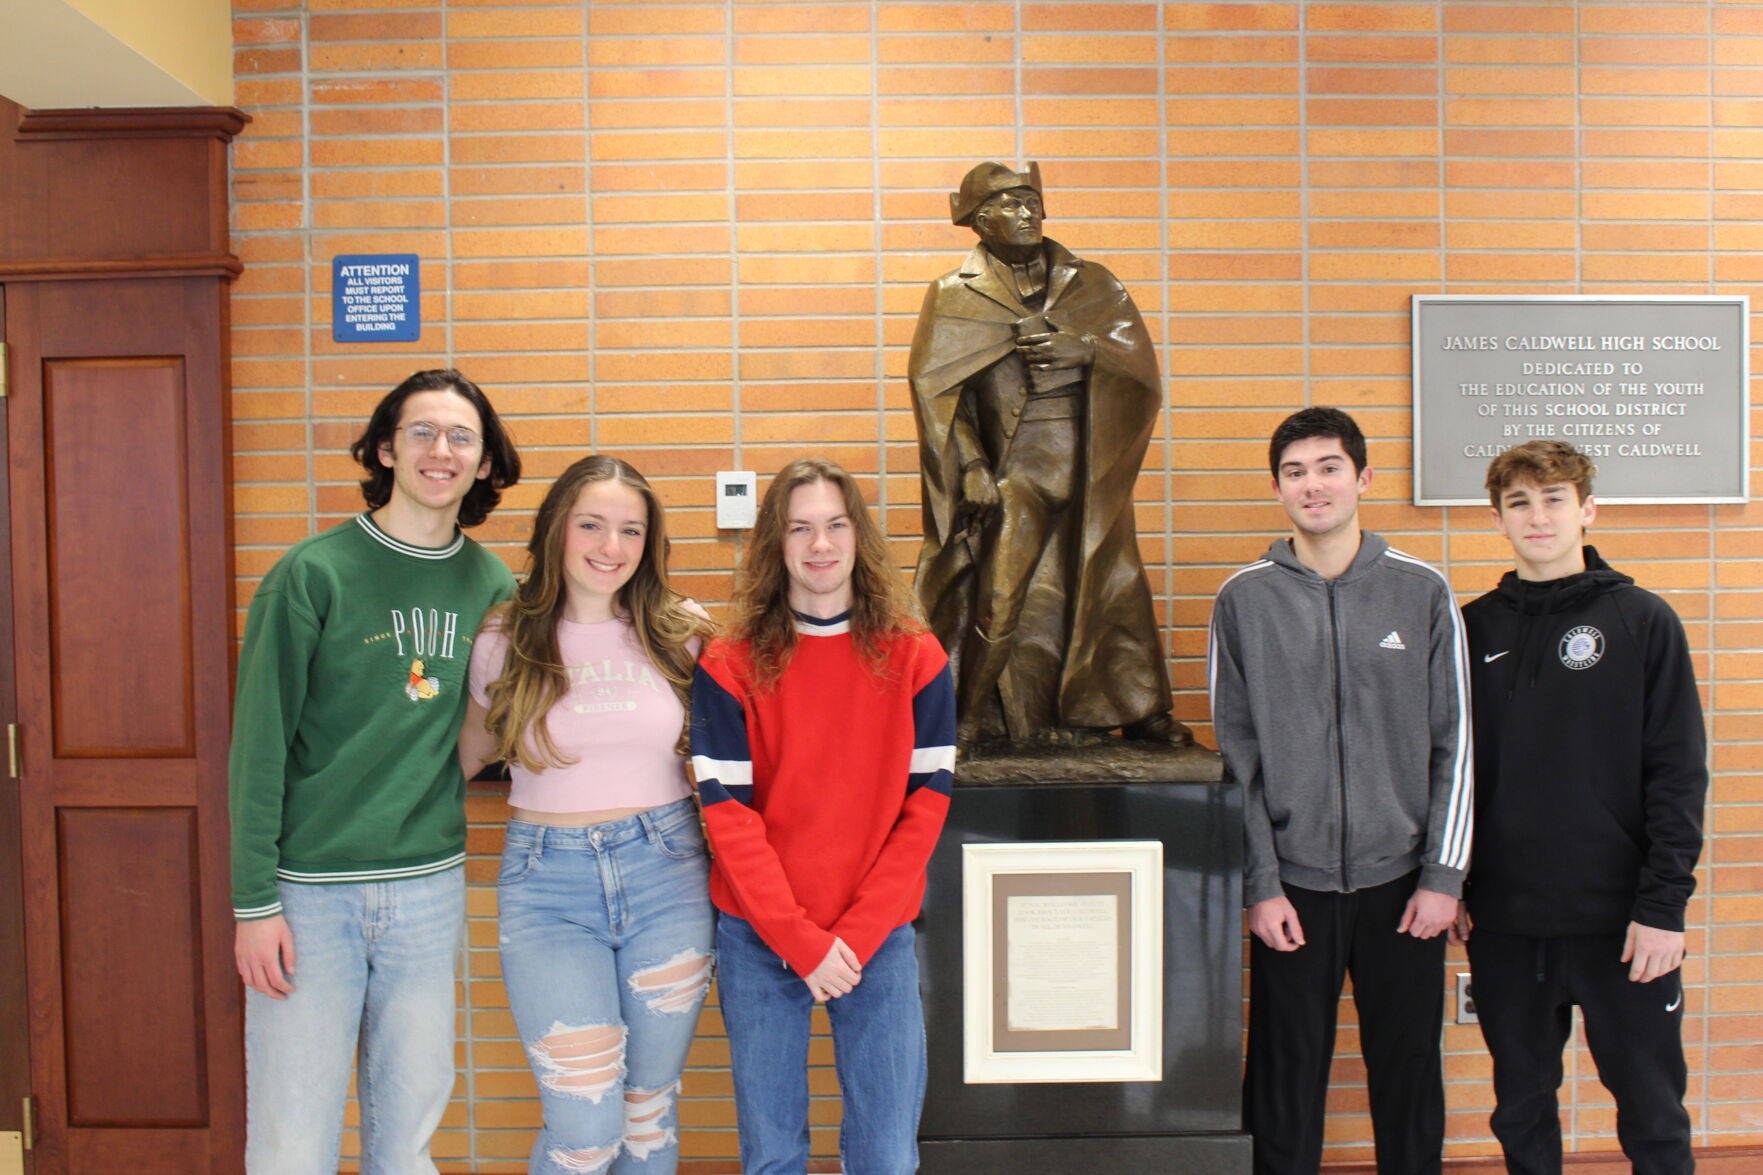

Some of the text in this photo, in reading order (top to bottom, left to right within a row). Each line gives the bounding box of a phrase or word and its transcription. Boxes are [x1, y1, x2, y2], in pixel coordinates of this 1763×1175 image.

[340, 264, 409, 277] ATTENTION
[347, 276, 403, 286] ALL VISITORS
[345, 285, 405, 295] MUST REPORT
[342, 294, 409, 304] TO THE SCHOOL
[347, 303, 404, 313] OFFICE UPON
[345, 312, 406, 323] ENTERING THE
[356, 322, 396, 331] BUILDING
[1442, 335, 1721, 350] JAMES CALDWELL HIGH SCHOOL
[1522, 362, 1644, 375] DEDICATED TO
[1459, 382, 1704, 396] THE EDUCATION OF THE YOUTH
[1478, 403, 1687, 416] OF THIS SCHOOL DISTRICT
[1503, 423, 1662, 436] BY THE CITIZENS OF
[1463, 444, 1511, 457] CALD
[1618, 443, 1702, 456] CALDWELL
[391, 607, 458, 658] POOH
